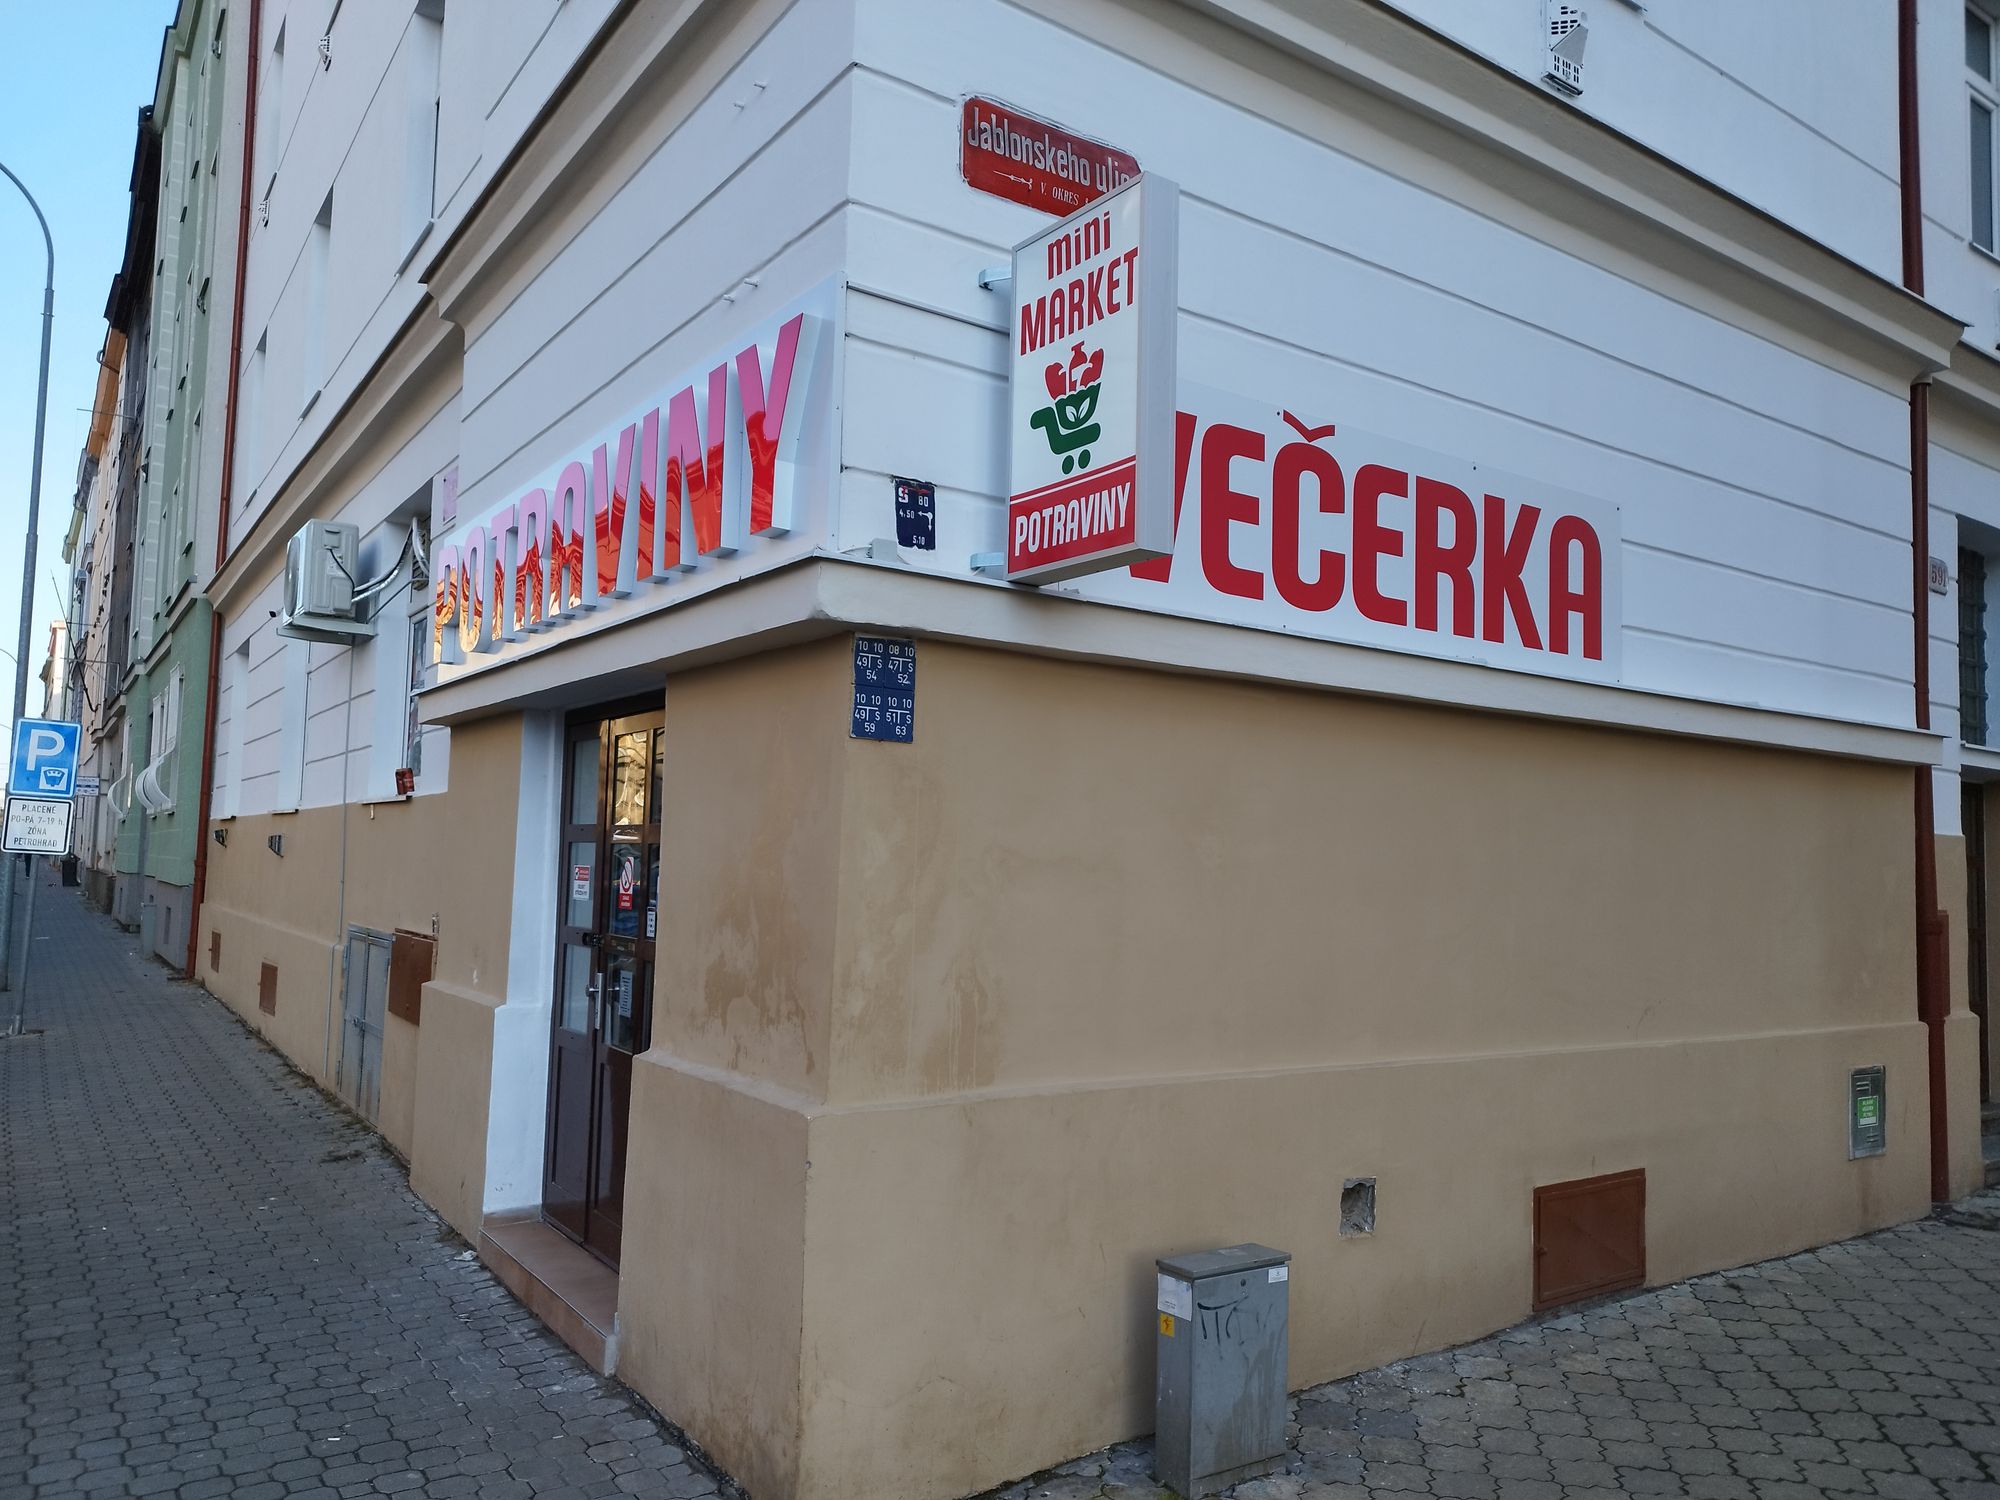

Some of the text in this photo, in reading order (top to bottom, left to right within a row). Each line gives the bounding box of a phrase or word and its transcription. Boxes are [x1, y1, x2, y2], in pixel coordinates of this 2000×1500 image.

[1047, 211, 1111, 281] mini
[1020, 246, 1138, 356] MARKET
[432, 312, 804, 664] POTRAVINY
[1014, 481, 1131, 557] POTRAVINY
[858, 641, 884, 653] 10 10
[904, 647, 914, 657] 10
[856, 693, 881, 705] 10 10
[887, 697, 912, 709] 10 10
[26, 729, 65, 771] P
[13, 837, 58, 847] PETROHRAD
